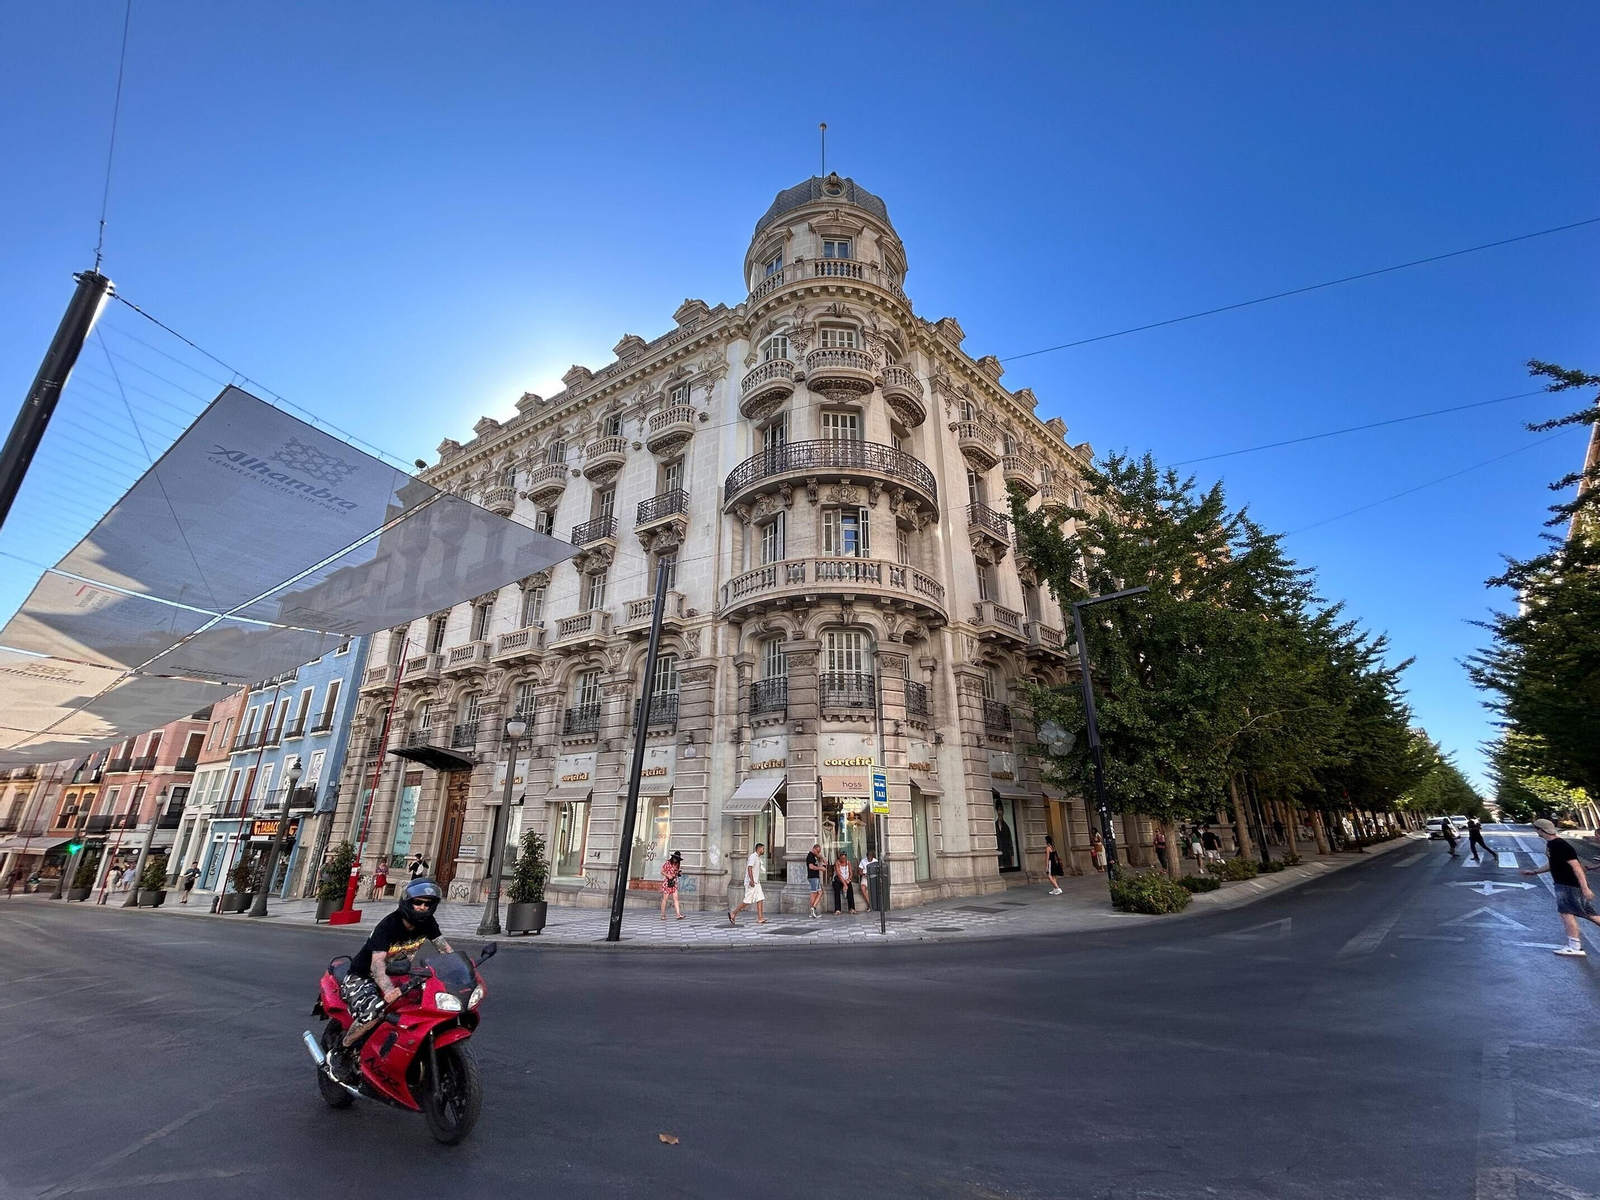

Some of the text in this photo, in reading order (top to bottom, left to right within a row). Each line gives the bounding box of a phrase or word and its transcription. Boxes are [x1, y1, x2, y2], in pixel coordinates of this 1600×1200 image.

[205, 444, 358, 511] Alhambra
[208, 456, 347, 516] CERVEZA HECHA SIN PRISA
[824, 756, 875, 768] cortefiel
[875, 790, 886, 798] TAXI
